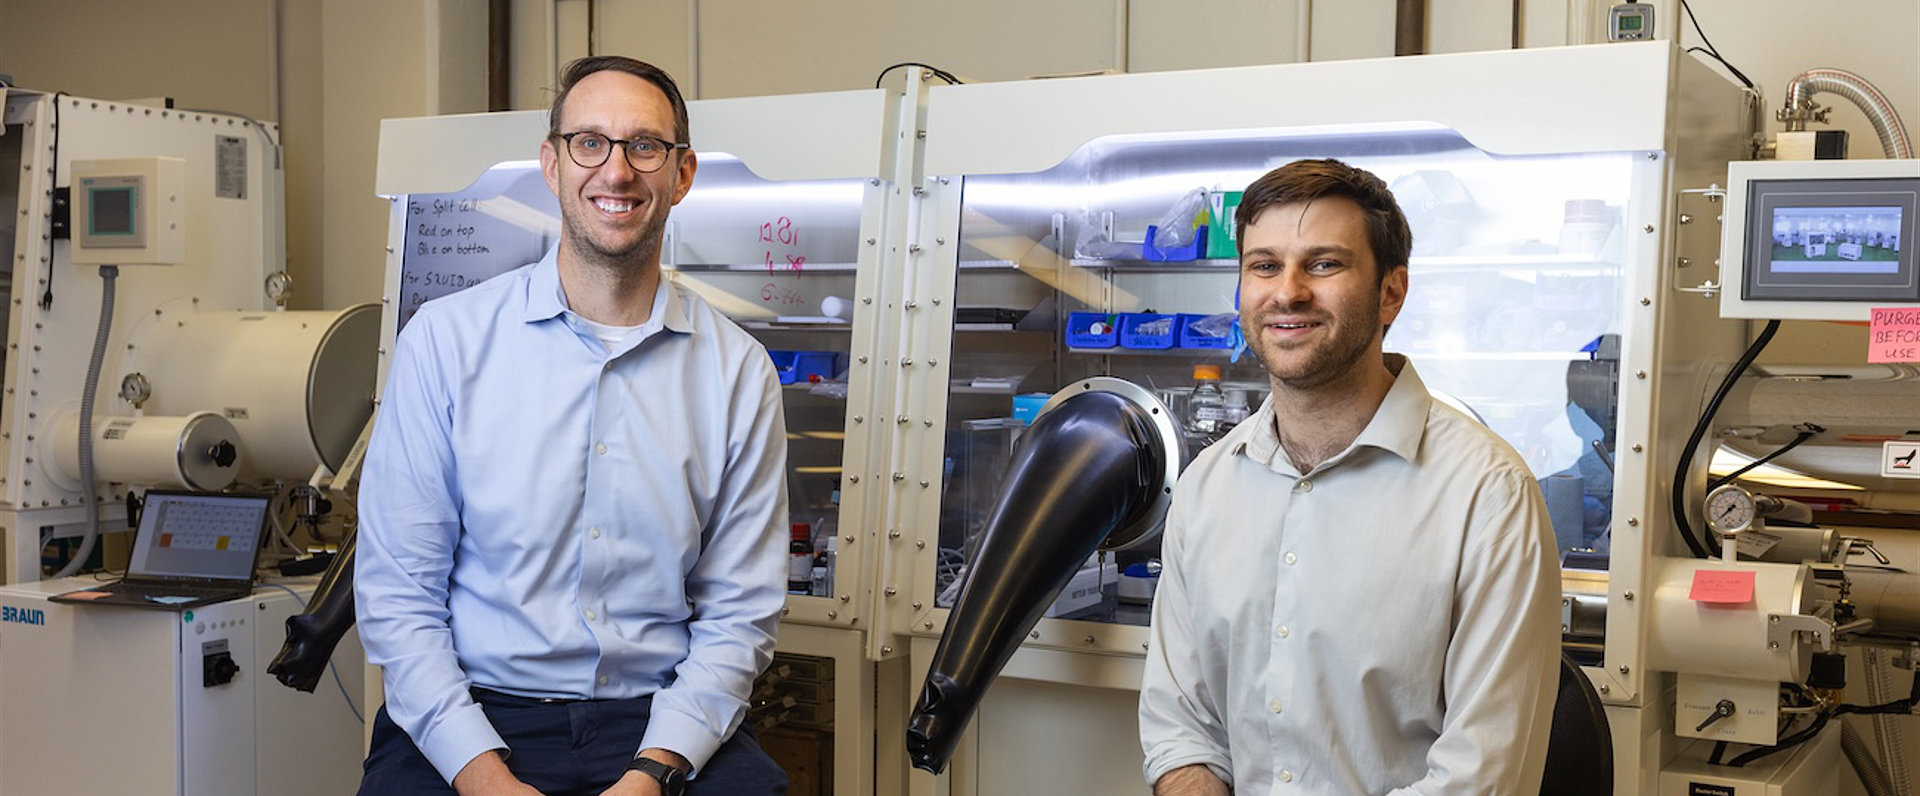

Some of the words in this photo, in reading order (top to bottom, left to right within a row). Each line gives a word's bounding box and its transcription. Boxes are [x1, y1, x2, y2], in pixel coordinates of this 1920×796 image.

[410, 201, 425, 215] For
[432, 199, 454, 218] Split
[459, 199, 478, 212] Cell
[418, 224, 437, 236] Red
[441, 228, 453, 236] on
[457, 224, 475, 238] top
[457, 243, 490, 254] bottom
[405, 271, 419, 284] For
[1886, 348, 1915, 358] USE
